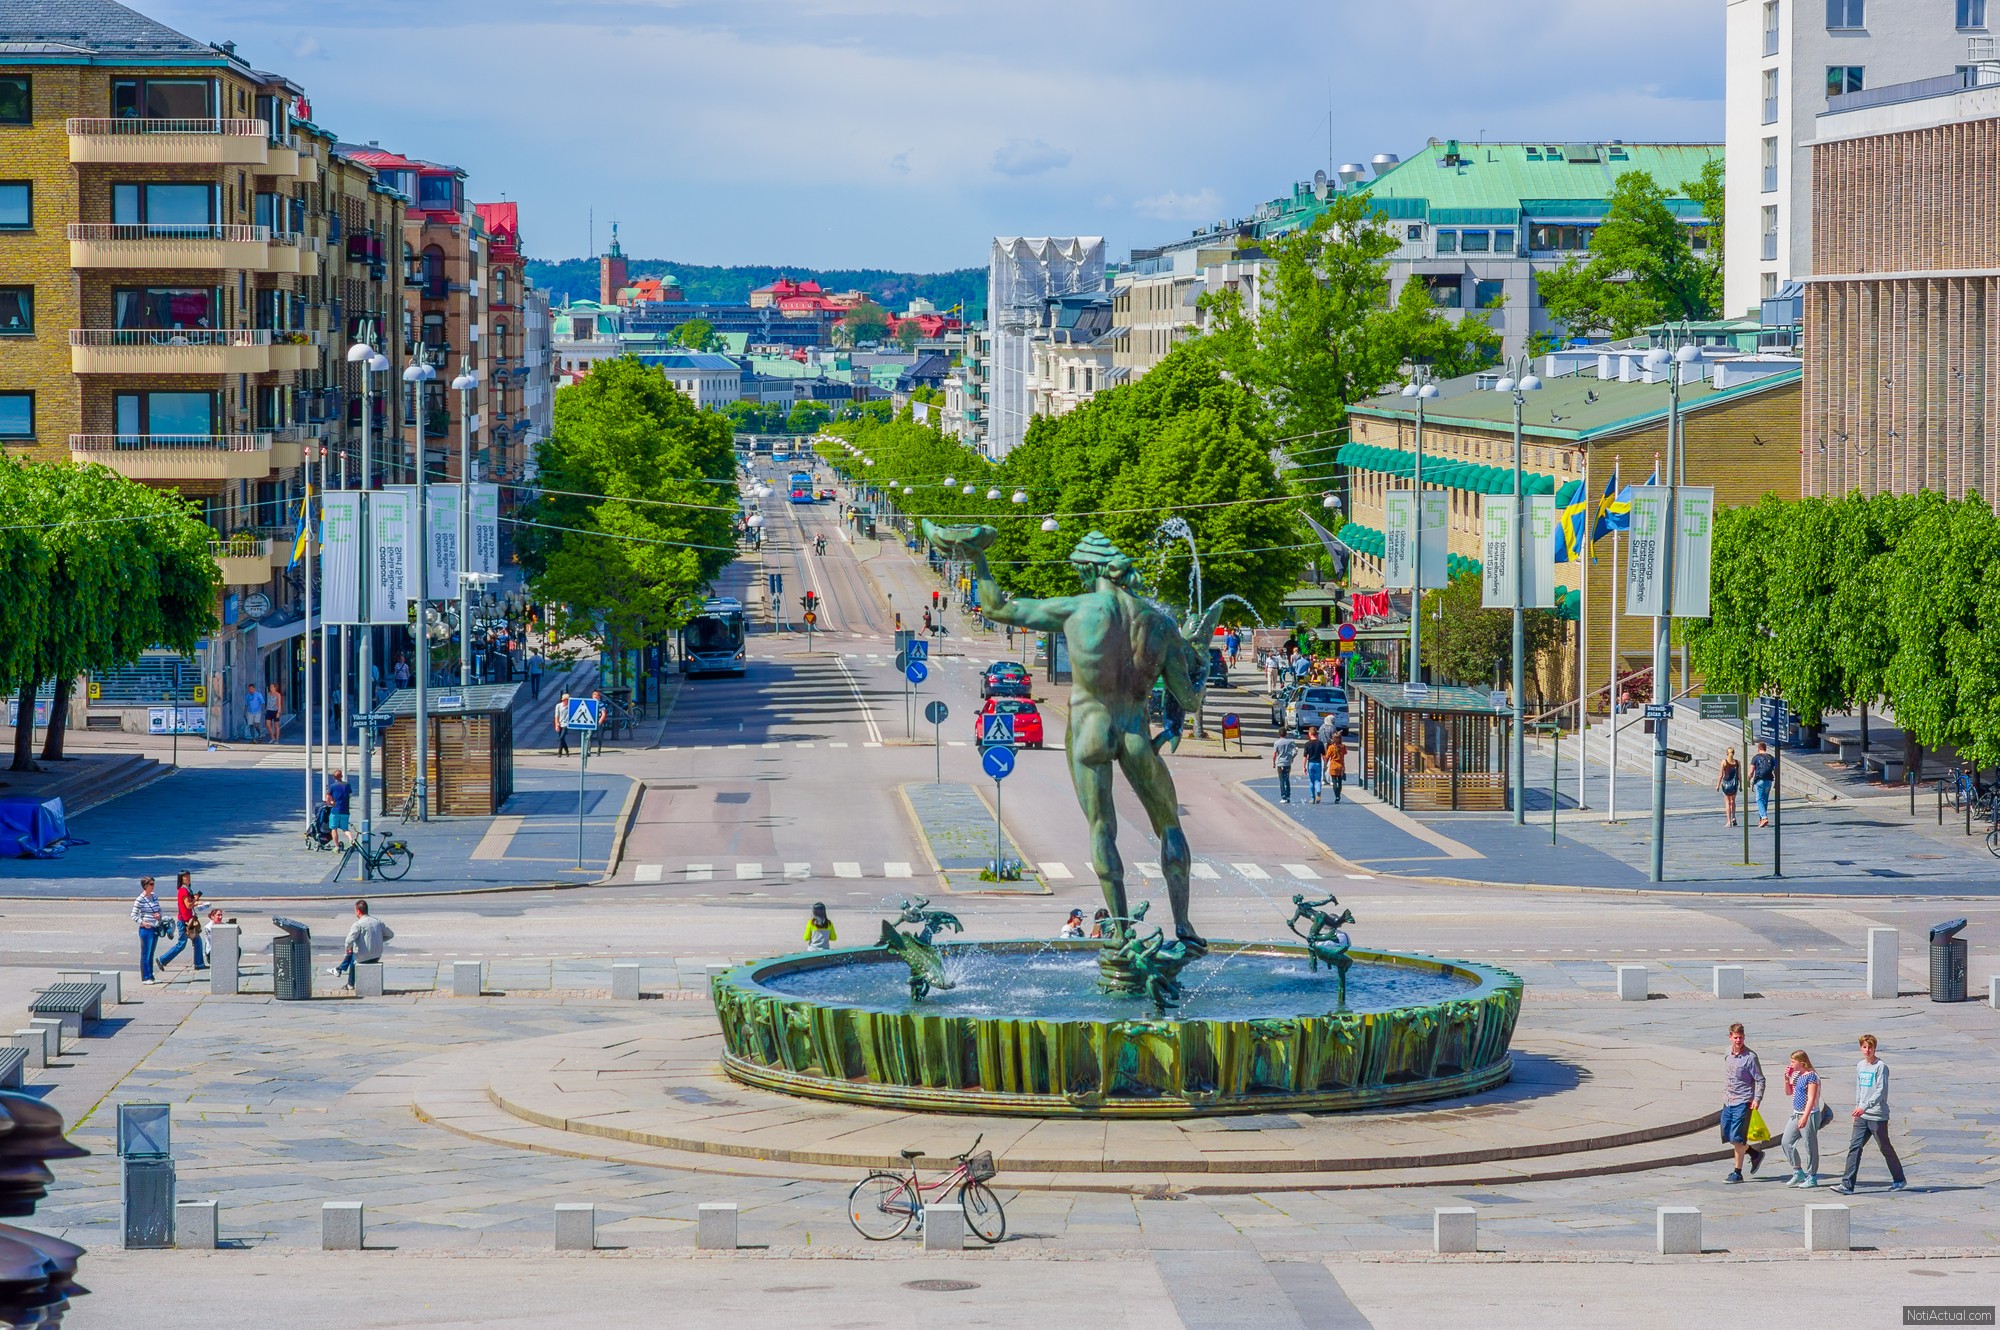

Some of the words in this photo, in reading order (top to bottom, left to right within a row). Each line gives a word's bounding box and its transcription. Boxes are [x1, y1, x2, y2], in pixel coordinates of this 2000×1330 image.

[1389, 499, 1407, 528] 5
[1427, 499, 1445, 528] 5
[1487, 506, 1507, 539] 5
[1530, 506, 1551, 539] 5
[1633, 498, 1658, 536] 5
[1683, 499, 1709, 537] 5
[1632, 539, 1641, 558] Start
[1639, 539, 1648, 562] första
[1646, 539, 1656, 580] Göteborgs
